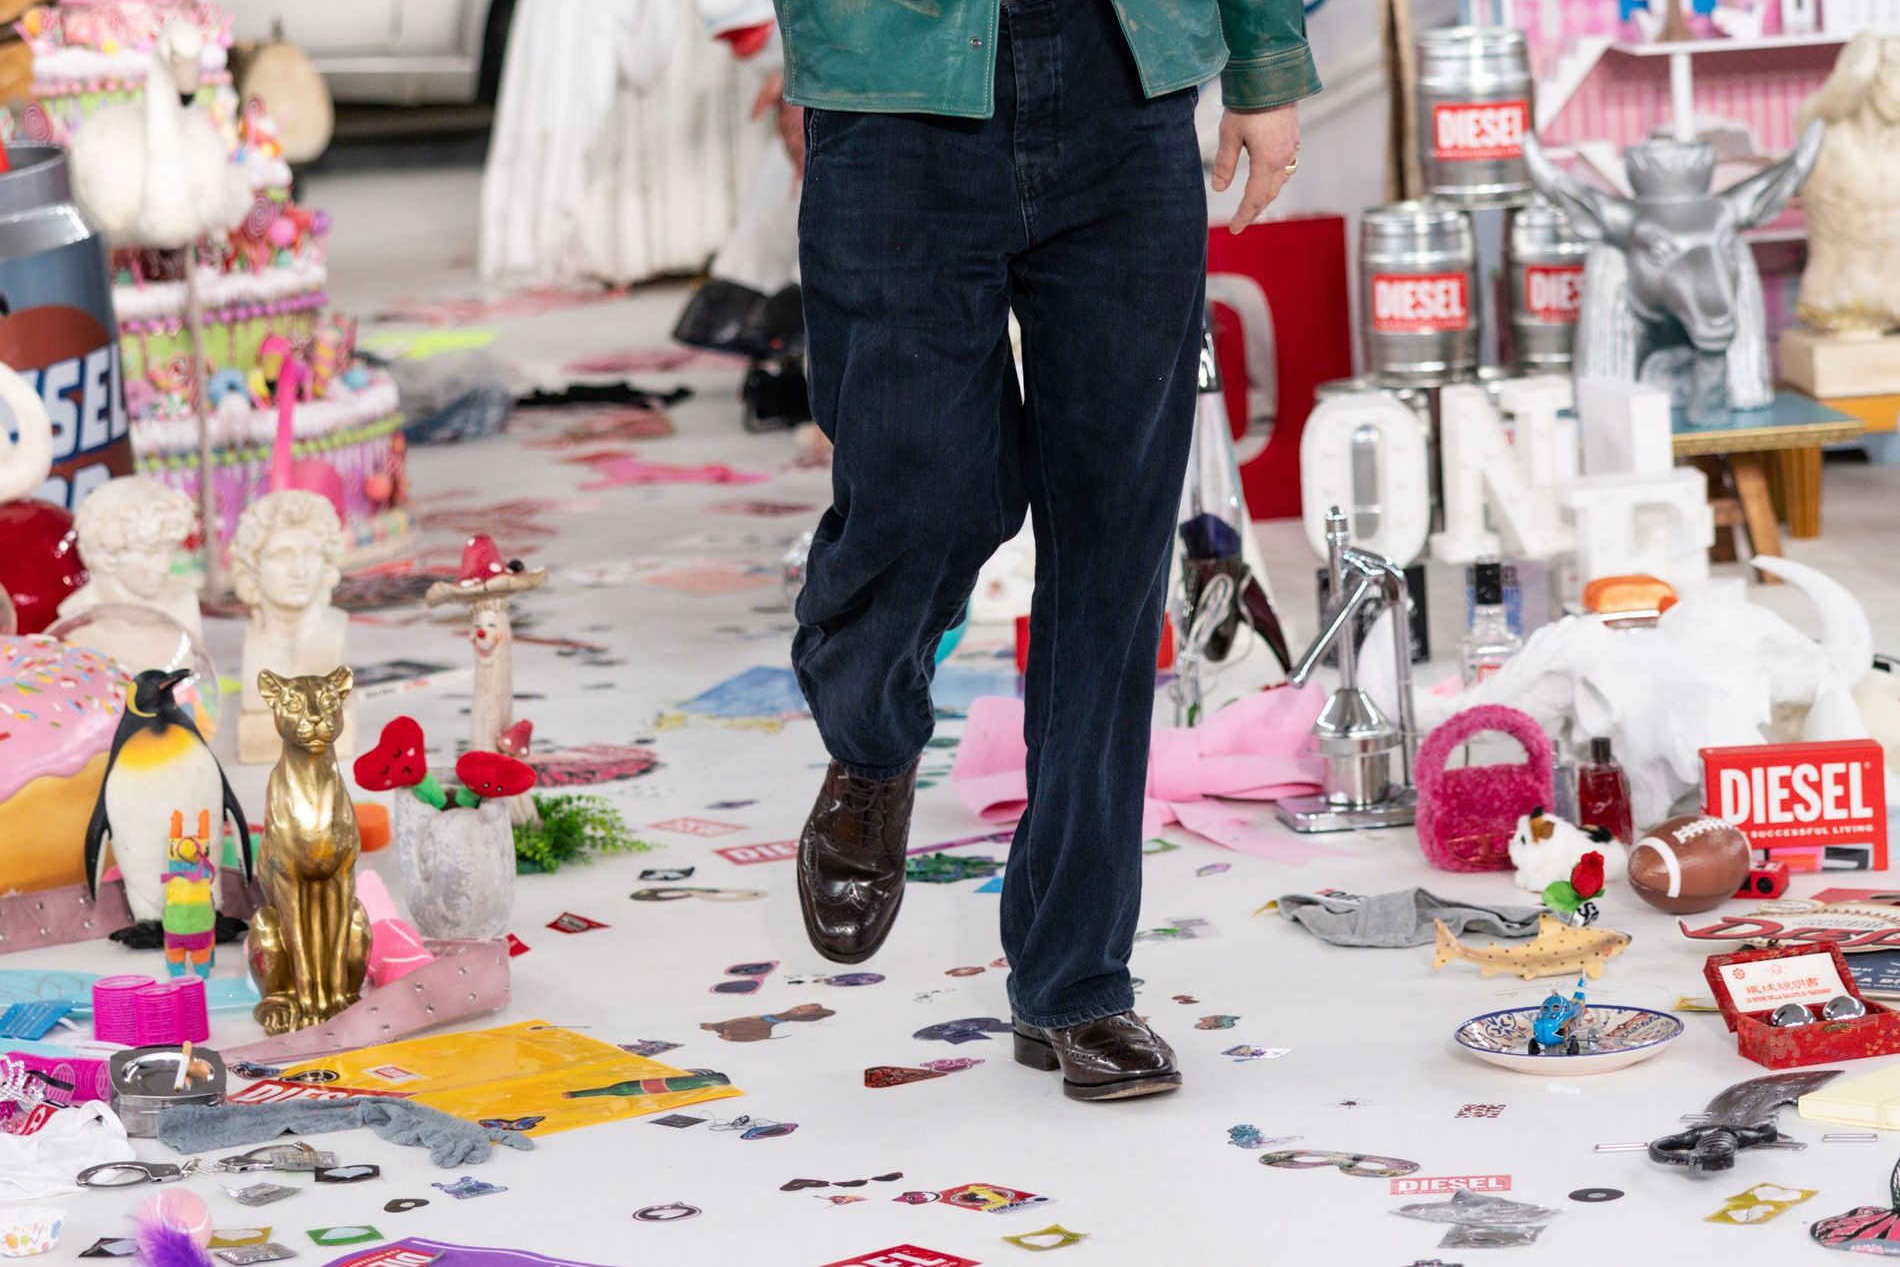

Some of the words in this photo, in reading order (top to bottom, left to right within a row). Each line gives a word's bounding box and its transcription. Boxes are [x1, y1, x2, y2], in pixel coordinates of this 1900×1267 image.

[1438, 107, 1522, 148] DIESEL
[1375, 279, 1467, 320] DIESEL
[1720, 762, 1874, 825] DIESEL
[1751, 826, 1830, 839] SUCCESSFUL
[1832, 824, 1874, 835] LIVING
[1398, 1177, 1504, 1190] DIESEL
